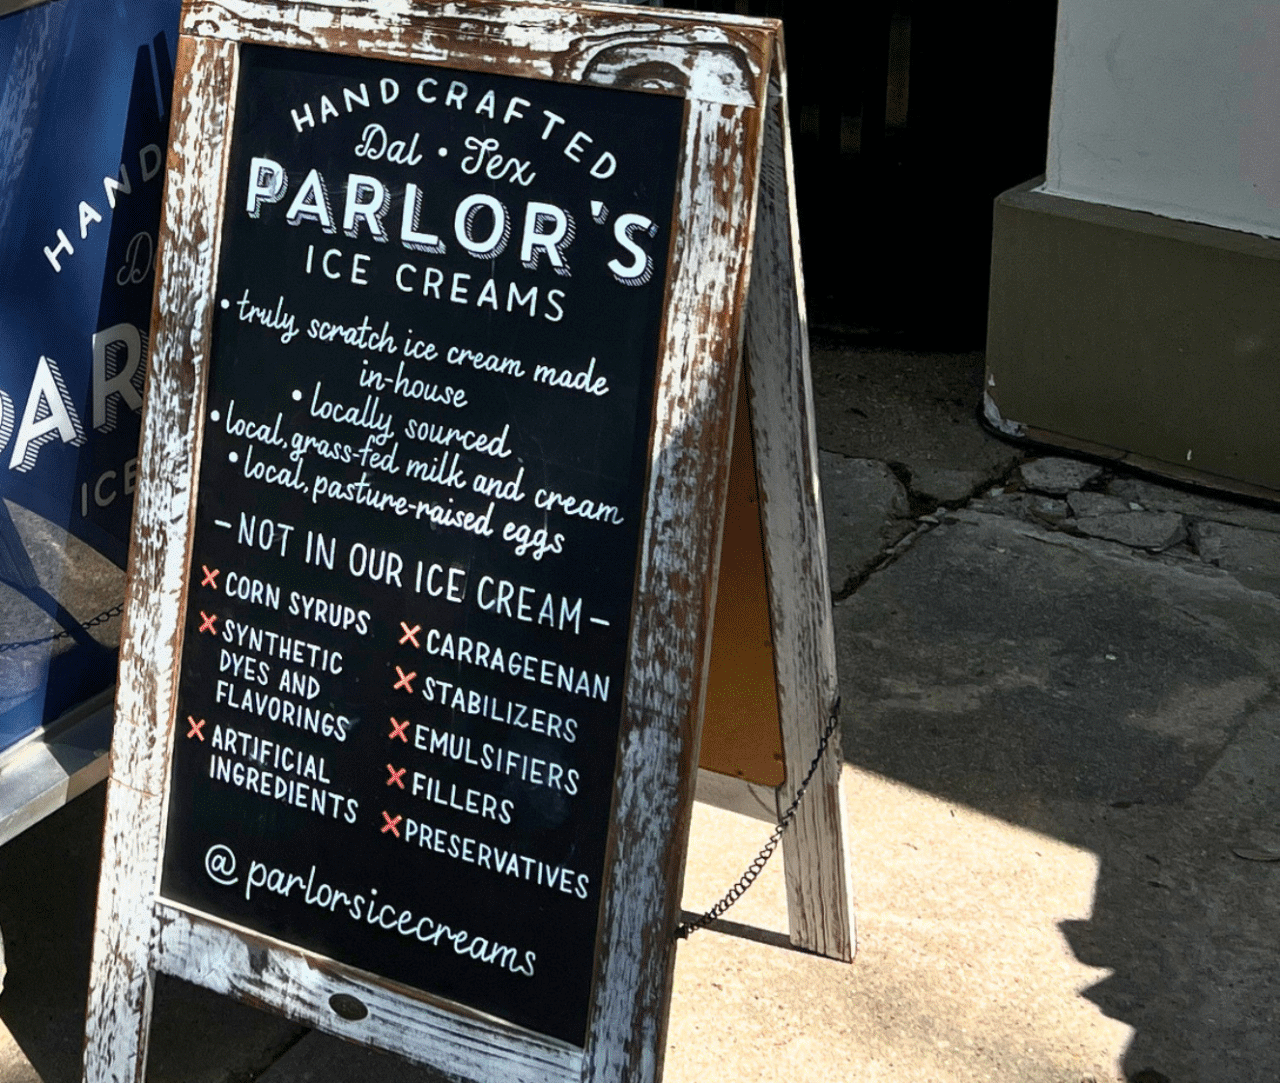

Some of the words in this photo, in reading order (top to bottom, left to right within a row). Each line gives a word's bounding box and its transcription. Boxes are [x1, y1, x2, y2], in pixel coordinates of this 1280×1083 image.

[290, 77, 618, 181] HANDCRAFTED
[354, 122, 423, 167] Dal
[460, 135, 537, 187] Tex
[246, 157, 659, 286] PARLOR'S
[117, 231, 161, 286] D
[305, 244, 372, 285] ICE
[395, 263, 567, 322] CREAMS
[237, 289, 300, 344] truly
[307, 314, 399, 355] scratch
[403, 329, 439, 362] ice
[446, 345, 526, 378] cream
[533, 357, 610, 396] made
[359, 359, 469, 409] in-house
[310, 382, 396, 445] locally
[404, 422, 513, 459] sourced
[406, 451, 468, 490] milk
[472, 467, 526, 502] and
[534, 487, 625, 526] cream
[305, 531, 336, 571] IN
[349, 543, 404, 588] OUR
[415, 560, 466, 603] ICE
[502, 522, 566, 560] eggs
[225, 571, 280, 611] CORN
[288, 590, 371, 636] SYRUPS
[219, 649, 270, 686] DYES
[279, 668, 321, 701] AND
[221, 620, 343, 675] SYNTHETIC
[426, 628, 611, 702] CARRAGEENAN
[216, 680, 350, 743] FLAVORINGS
[422, 676, 578, 744] STABILIZERS
[209, 754, 359, 824] INGREDIENTS
[211, 724, 331, 785] ARTIFICIAL
[414, 724, 580, 796] EMULSIFIERS
[411, 772, 515, 825] FILLERS
[405, 818, 590, 900] PRESERVATIVES
